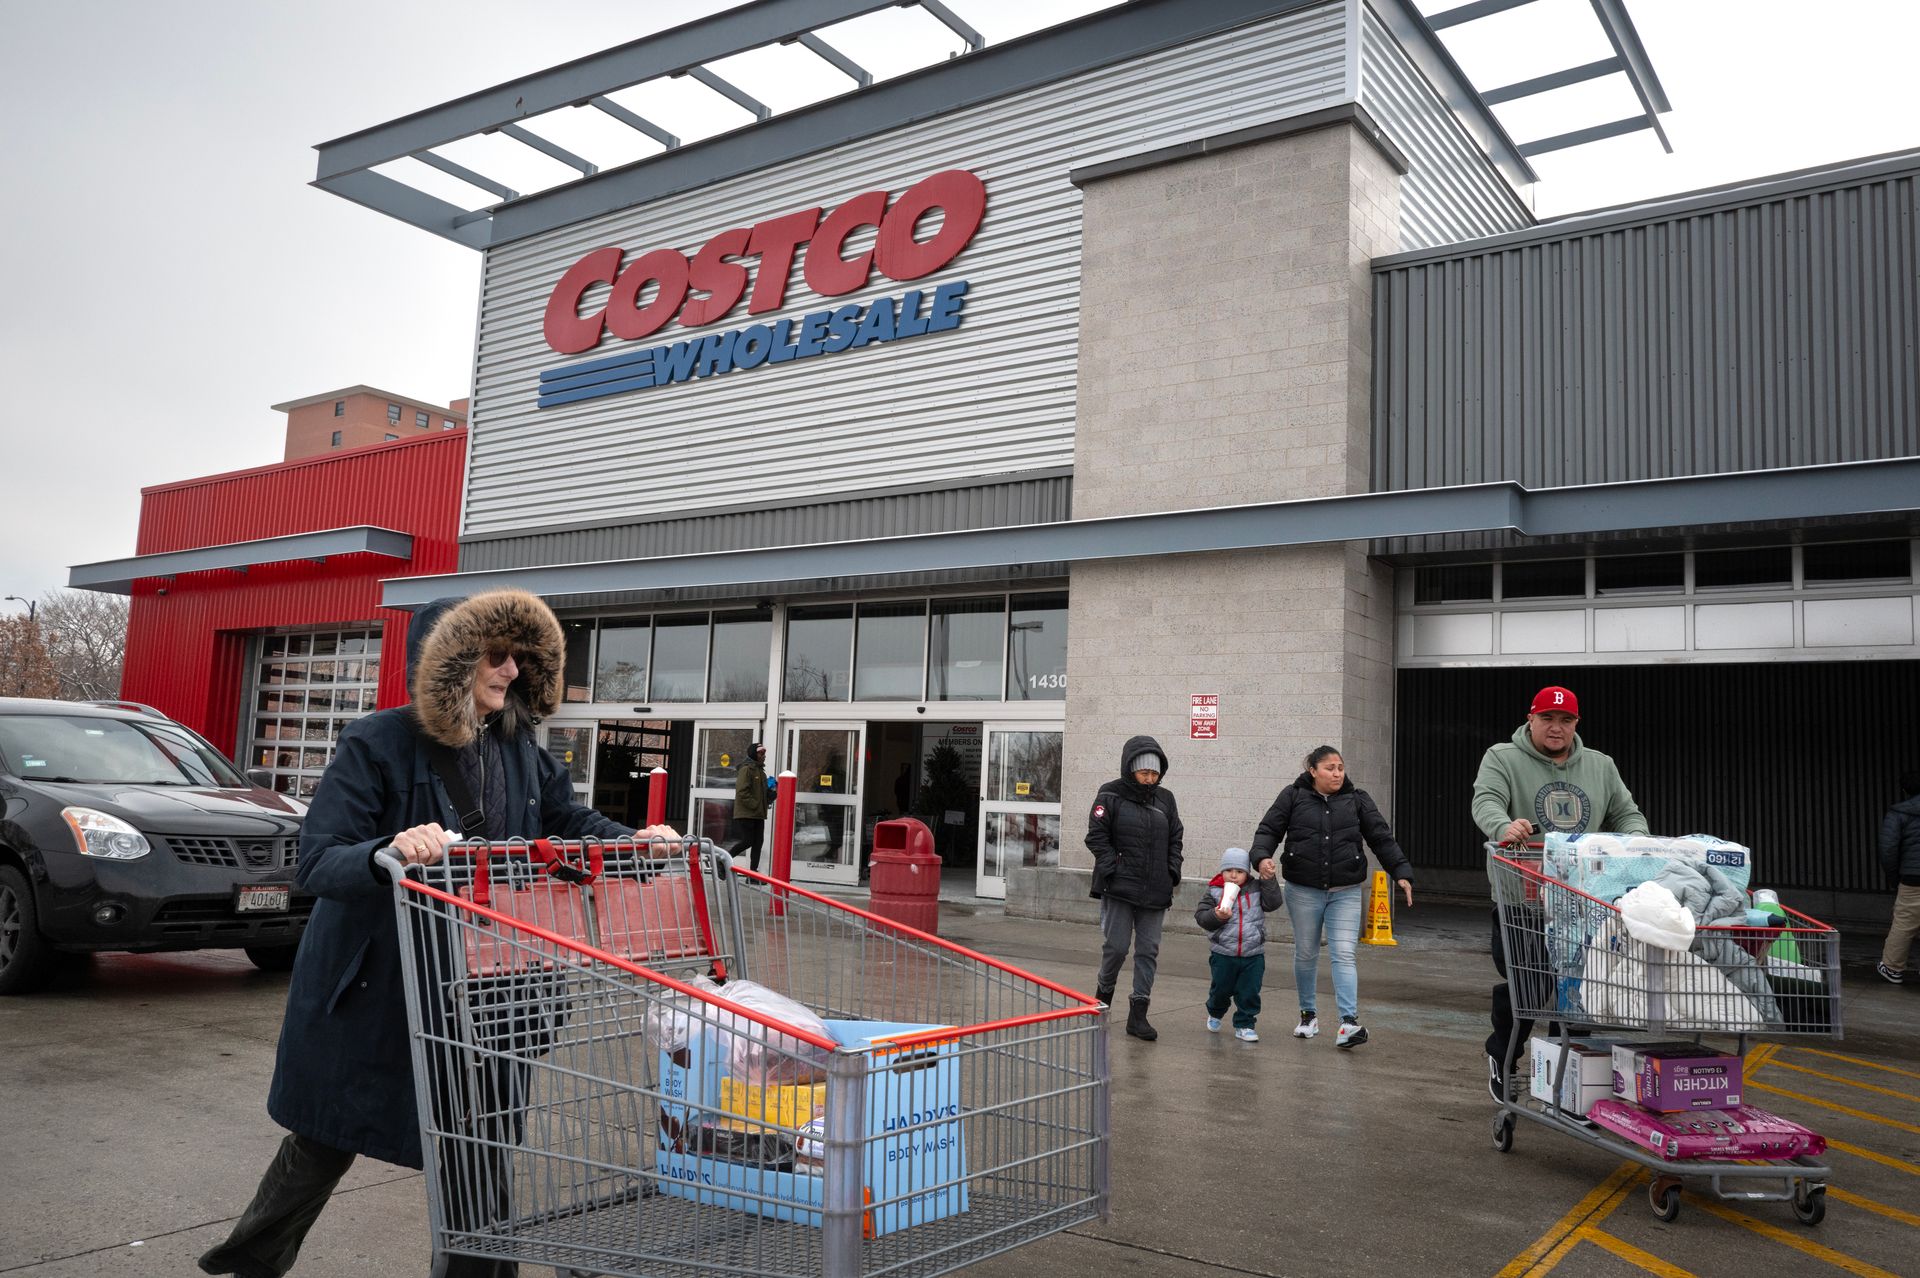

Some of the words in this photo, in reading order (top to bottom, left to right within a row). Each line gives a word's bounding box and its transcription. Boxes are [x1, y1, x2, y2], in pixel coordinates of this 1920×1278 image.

[543, 169, 987, 354] COSTCO
[652, 280, 969, 386] WHOLESALE
[1030, 674, 1067, 689] 1430
[1192, 696, 1203, 705] FIRE
[1203, 696, 1217, 705] LANE
[1552, 691, 1564, 705] B
[1192, 719, 1203, 727] TOW
[1692, 1066, 1715, 1075] GALLON
[1674, 1076, 1728, 1092] KITCHEN
